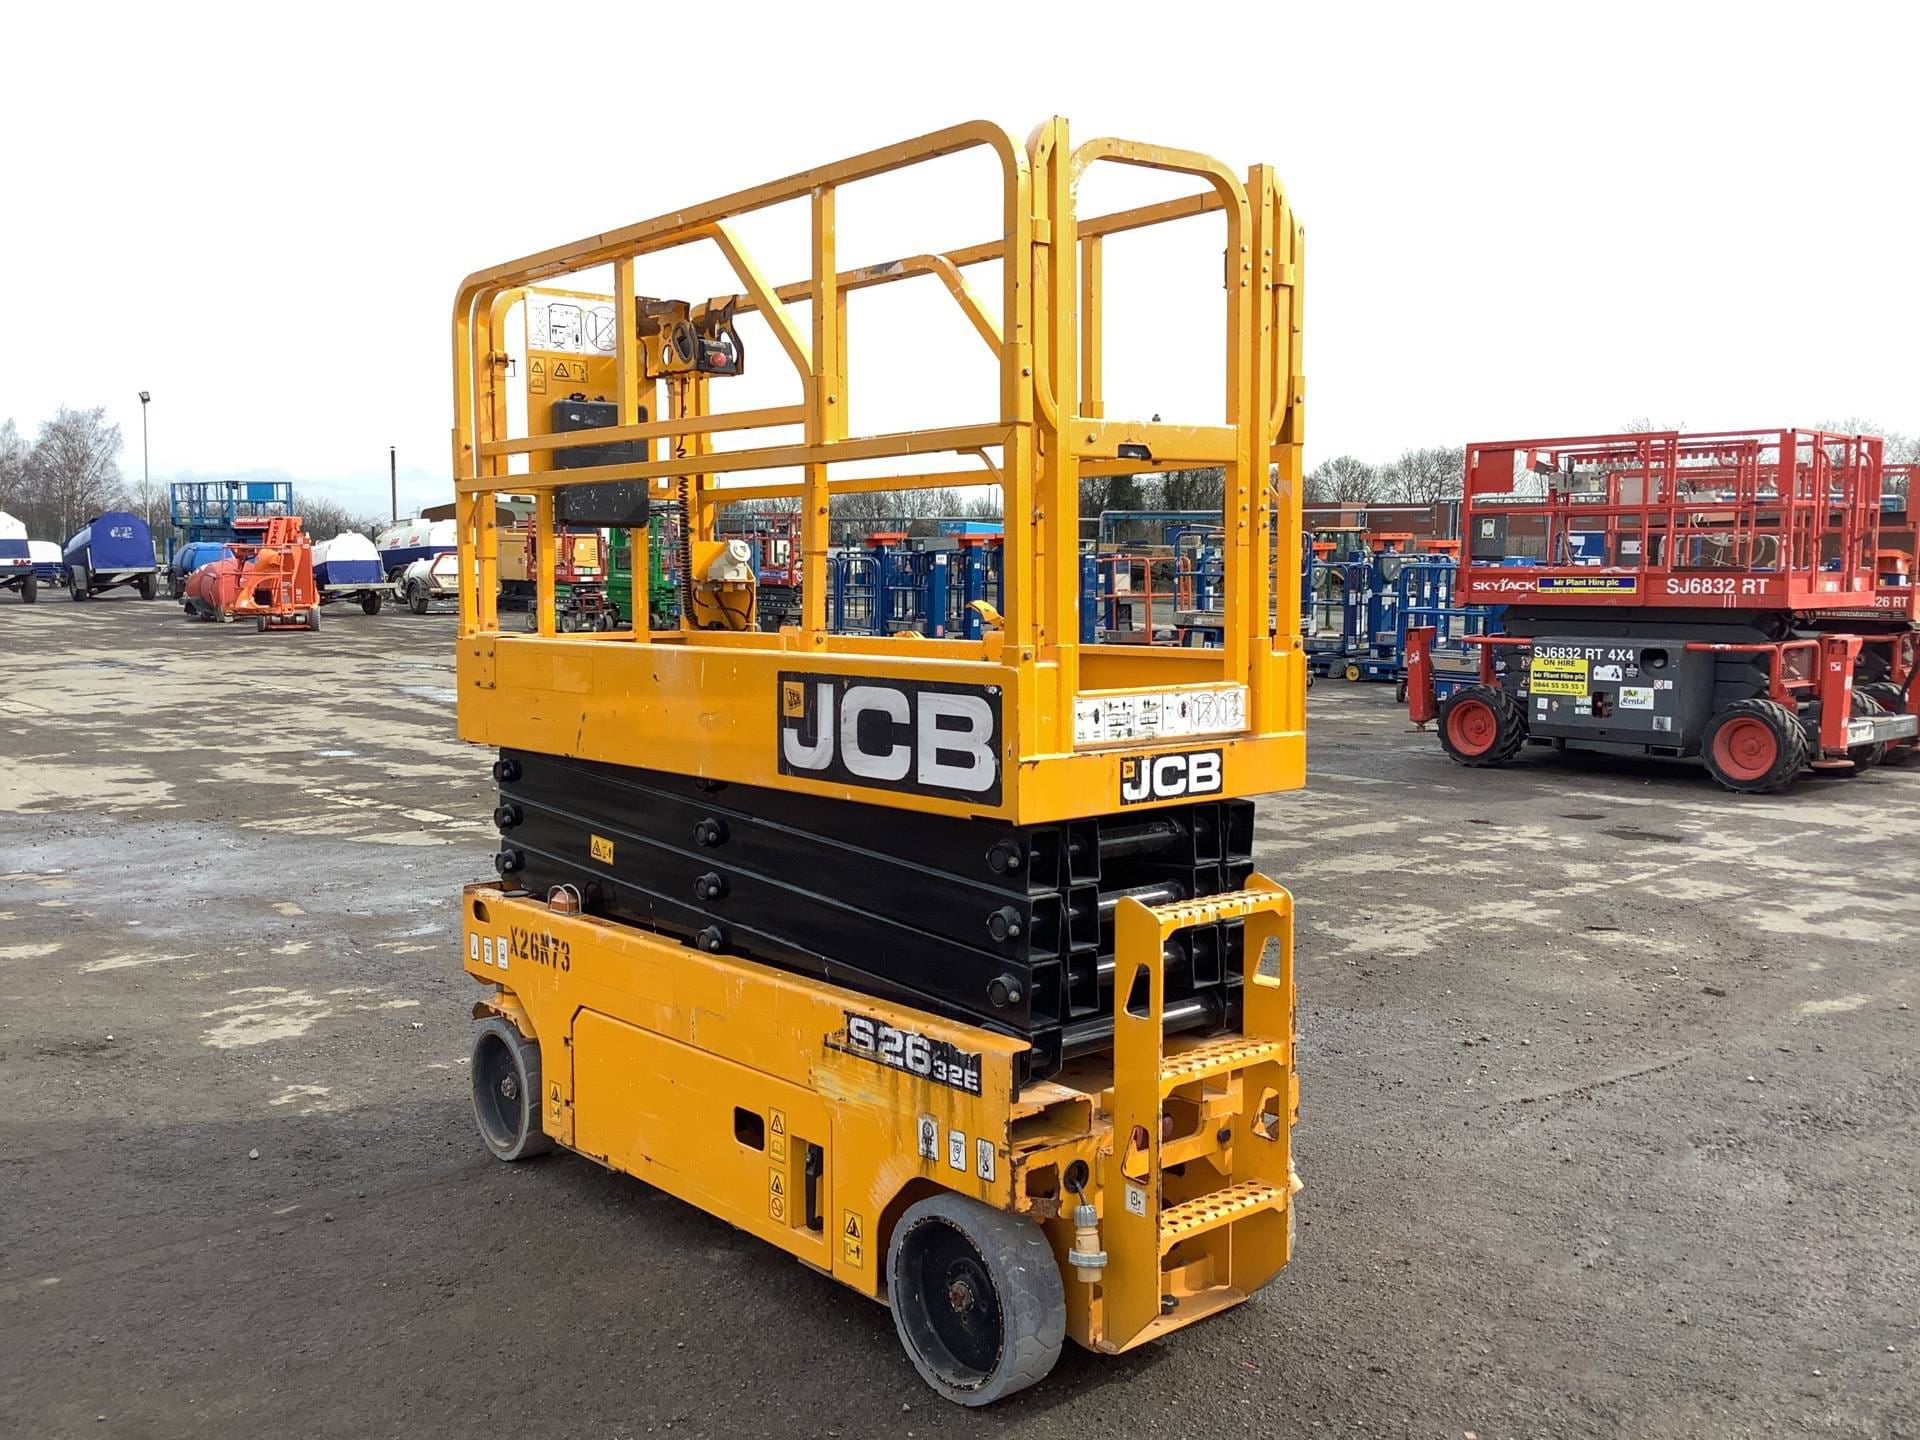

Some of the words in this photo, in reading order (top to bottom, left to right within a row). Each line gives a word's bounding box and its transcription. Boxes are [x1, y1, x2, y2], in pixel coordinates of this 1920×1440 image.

[1472, 578, 1536, 592] SKYJACK
[1606, 579, 1619, 588] plc
[1666, 578, 1736, 594] SJ6832
[1742, 578, 1769, 594] RT
[1893, 596, 1909, 608] RT
[1534, 646, 1581, 659] SJ6832
[1585, 648, 1604, 660] RT
[1608, 649, 1634, 661] 4X4
[783, 683, 996, 792] JCB
[1122, 752, 1221, 801] JCB
